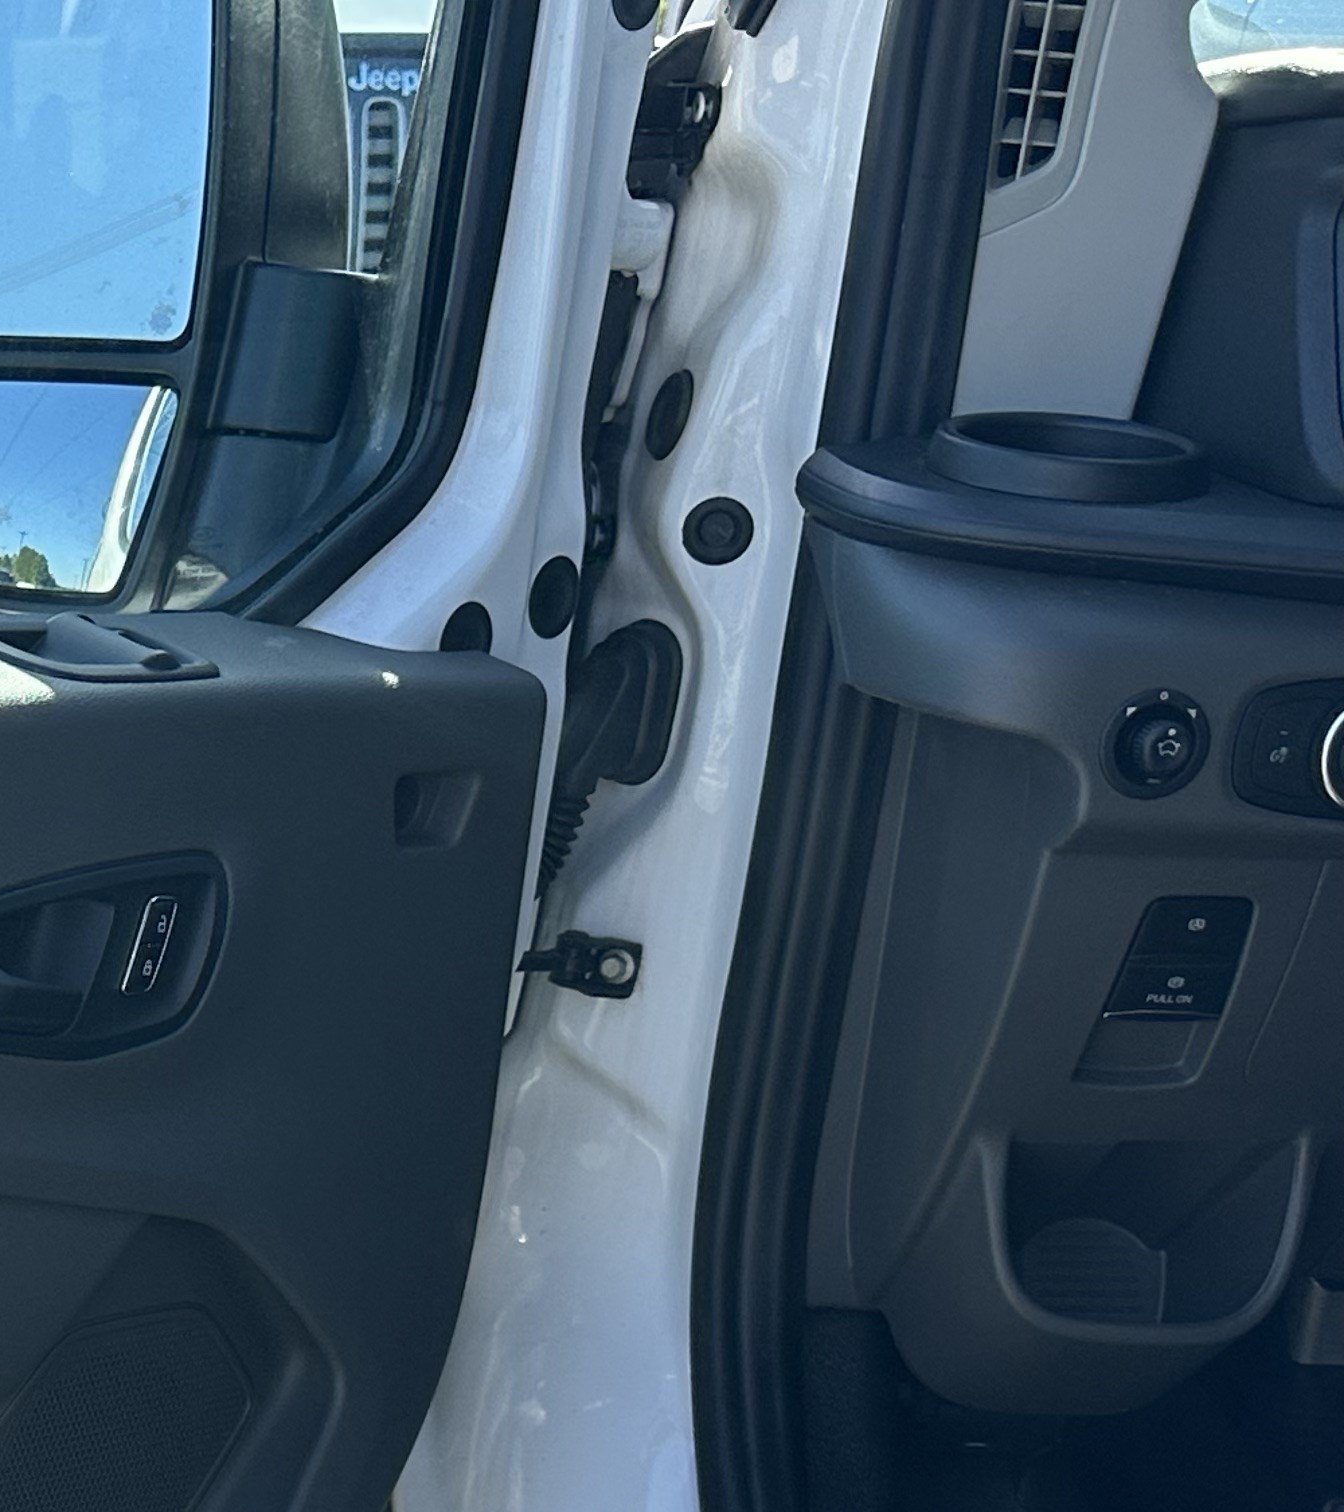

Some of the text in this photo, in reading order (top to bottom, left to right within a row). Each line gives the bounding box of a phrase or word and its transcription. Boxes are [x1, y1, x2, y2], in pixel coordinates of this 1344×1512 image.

[348, 61, 419, 97] Jeep
[1145, 993, 1193, 1004] PULL ON
